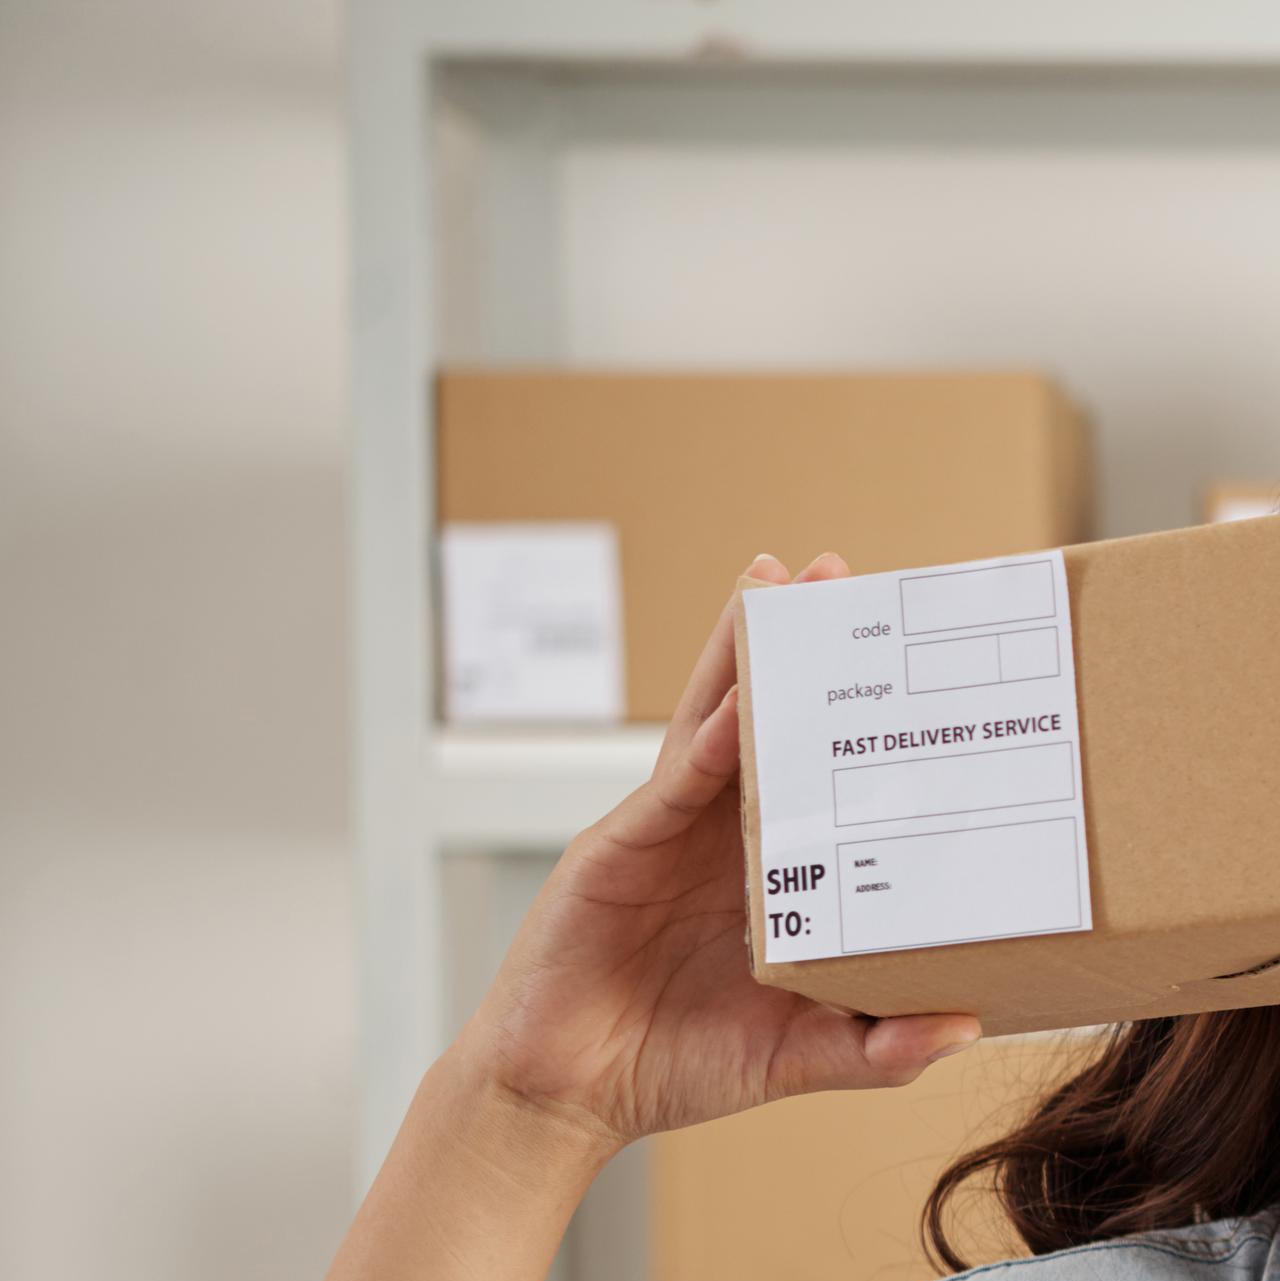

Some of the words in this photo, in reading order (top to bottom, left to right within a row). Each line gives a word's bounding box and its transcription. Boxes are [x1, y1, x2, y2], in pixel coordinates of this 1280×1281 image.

[853, 622, 890, 639] code
[828, 684, 892, 705] package
[833, 736, 878, 757] FAST
[884, 725, 976, 751] DELIVERY
[983, 714, 1061, 739] SERVICE
[767, 864, 825, 895] SHIP
[769, 911, 810, 938] TO:
